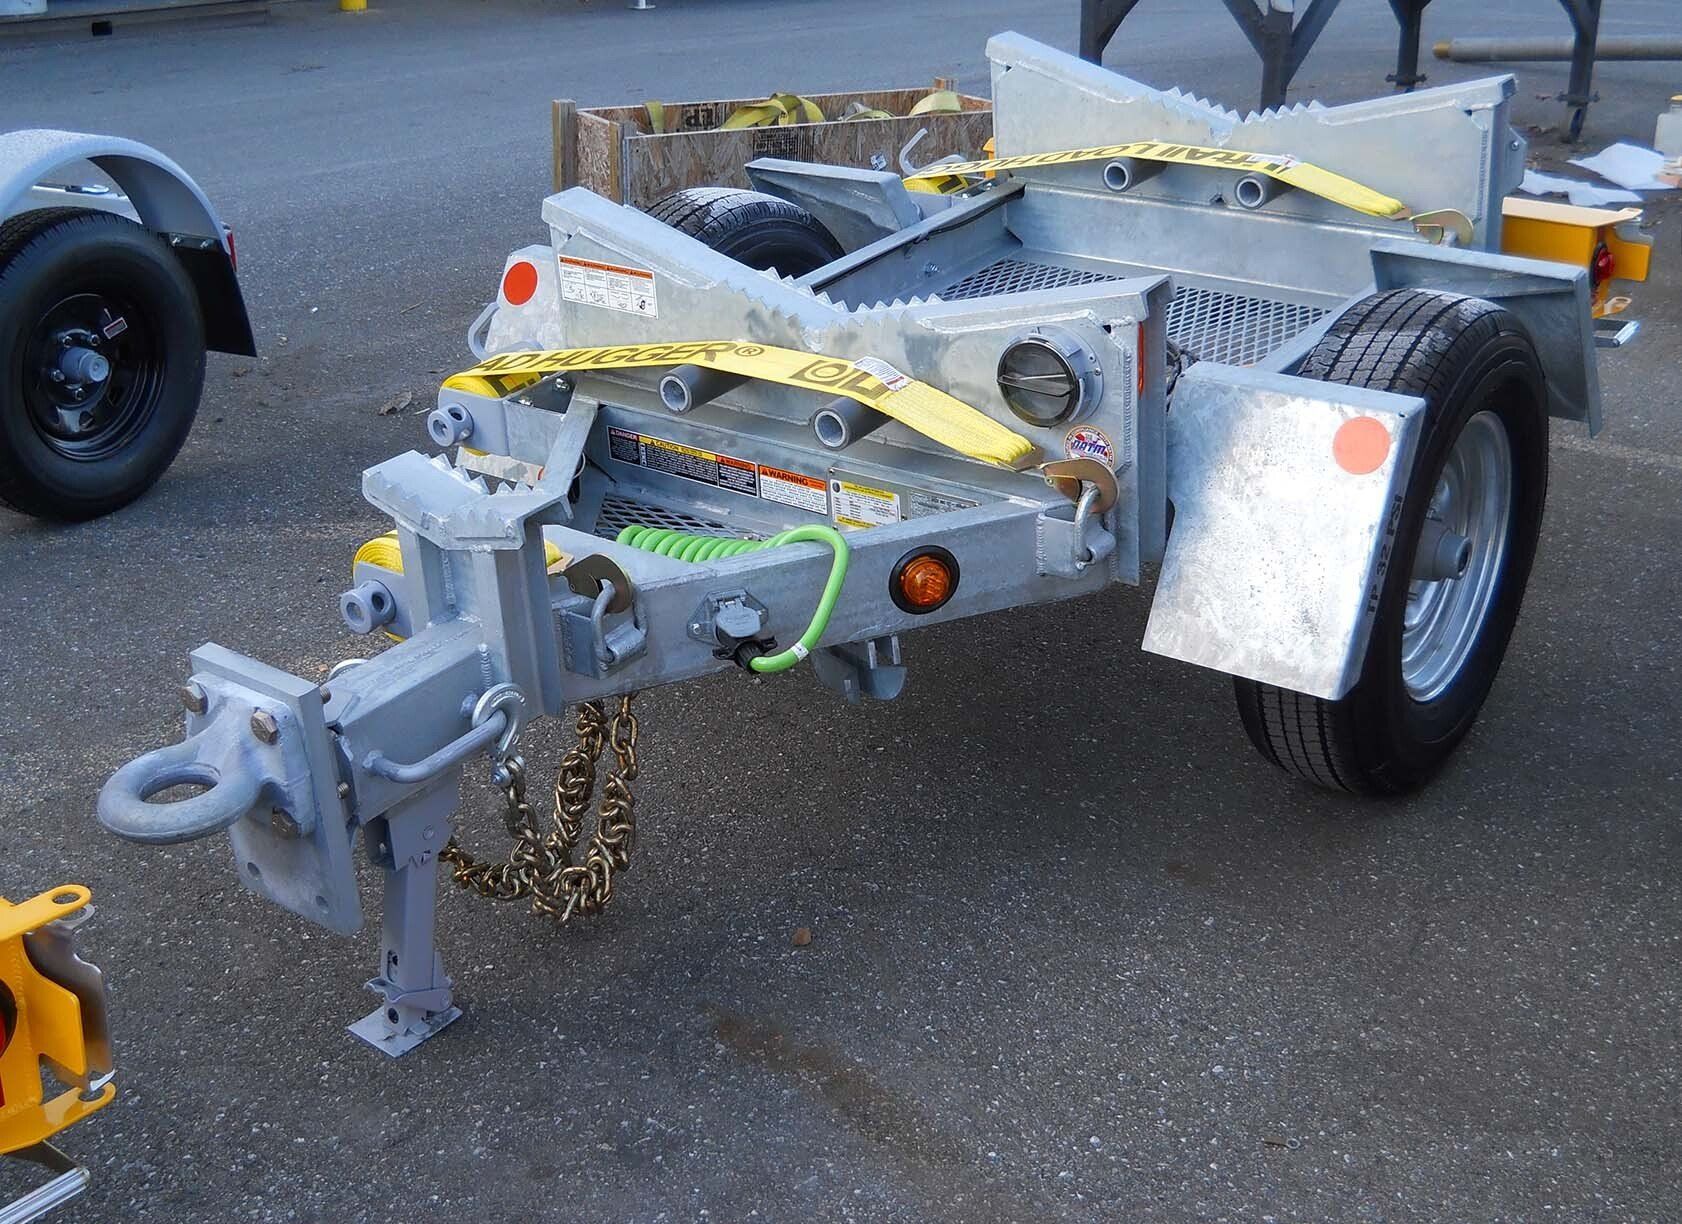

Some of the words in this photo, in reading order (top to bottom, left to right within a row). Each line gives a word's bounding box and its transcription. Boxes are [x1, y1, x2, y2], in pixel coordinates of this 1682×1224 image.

[767, 469, 809, 486] WARNING
[1377, 544, 1390, 576] 32
[1387, 494, 1402, 536] PSI
